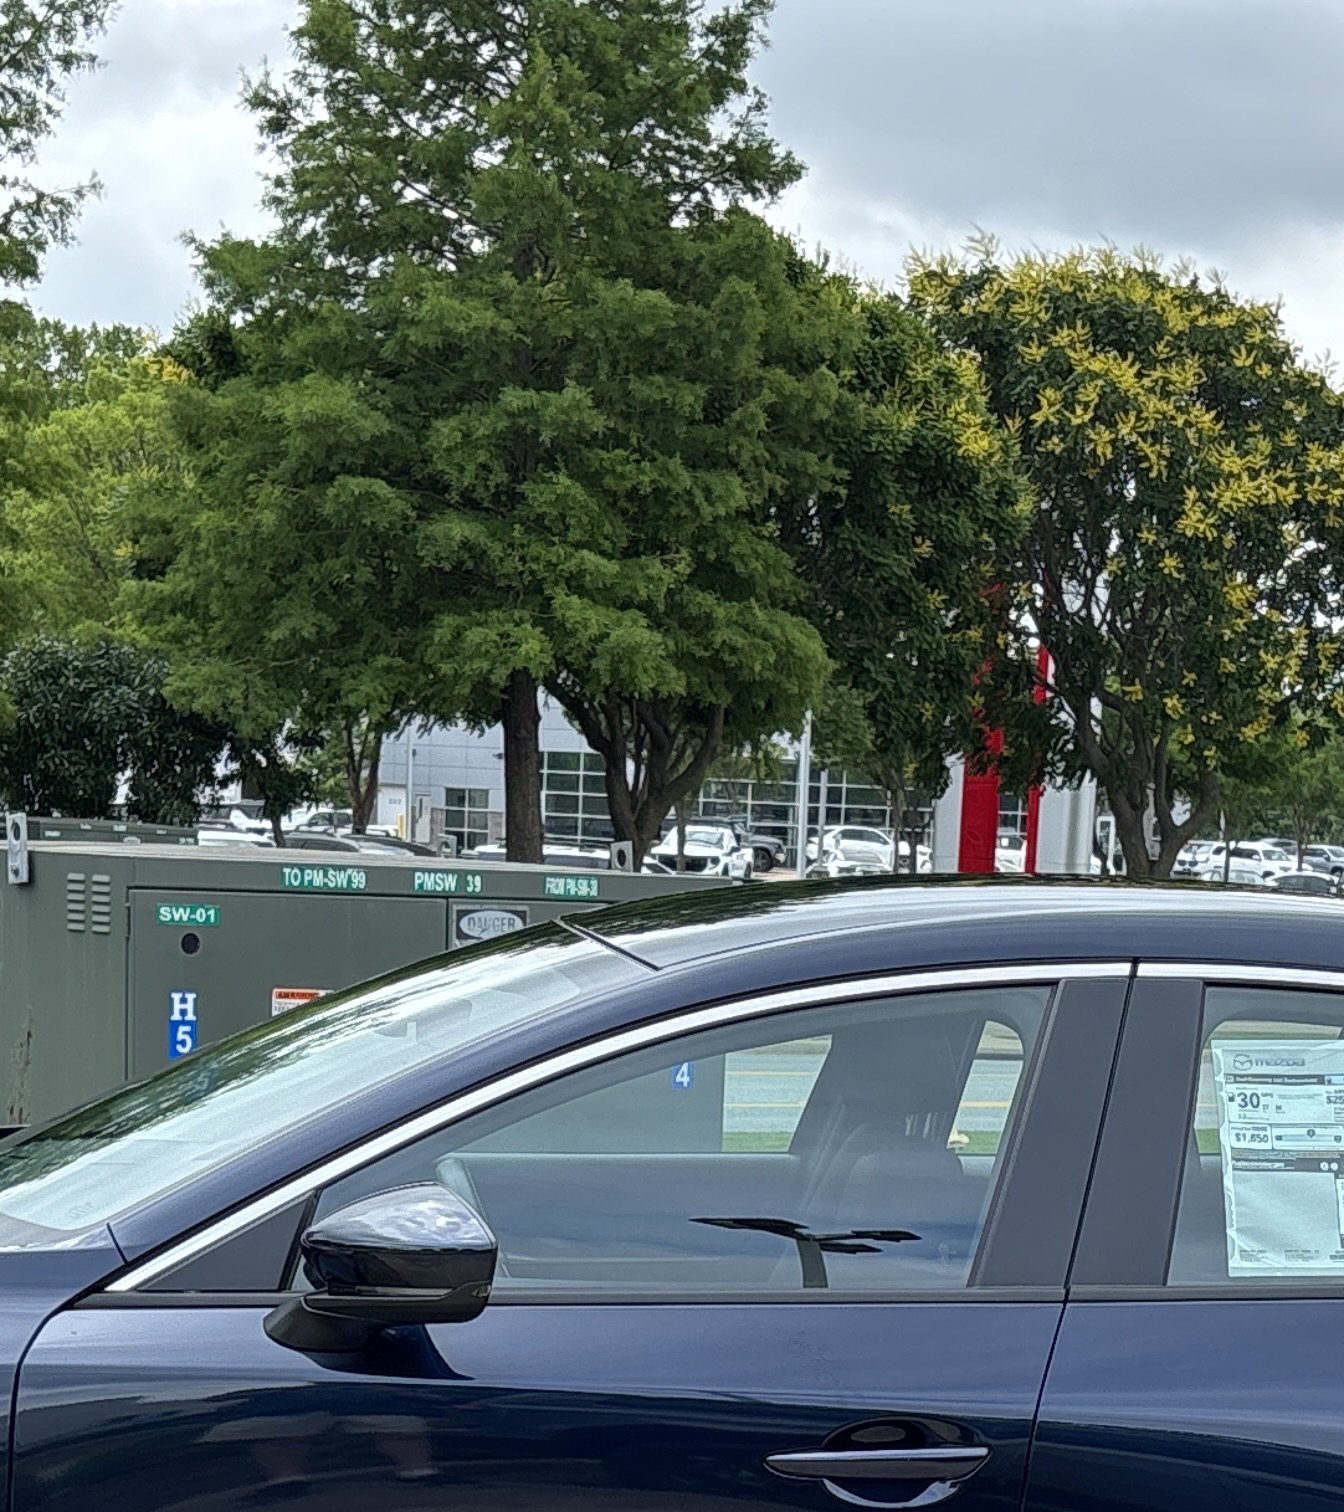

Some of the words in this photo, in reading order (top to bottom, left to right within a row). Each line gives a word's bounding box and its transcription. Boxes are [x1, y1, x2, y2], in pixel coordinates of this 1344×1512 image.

[283, 867, 301, 887] TO
[304, 868, 348, 888] PM-SW
[351, 870, 366, 889] 99
[414, 871, 458, 891] PMSW
[466, 874, 482, 893] 39
[158, 905, 216, 923] SW-01
[170, 992, 197, 1021] H
[175, 1025, 193, 1054] 5
[675, 1062, 691, 1088] 4
[1237, 1092, 1260, 1109] 30
